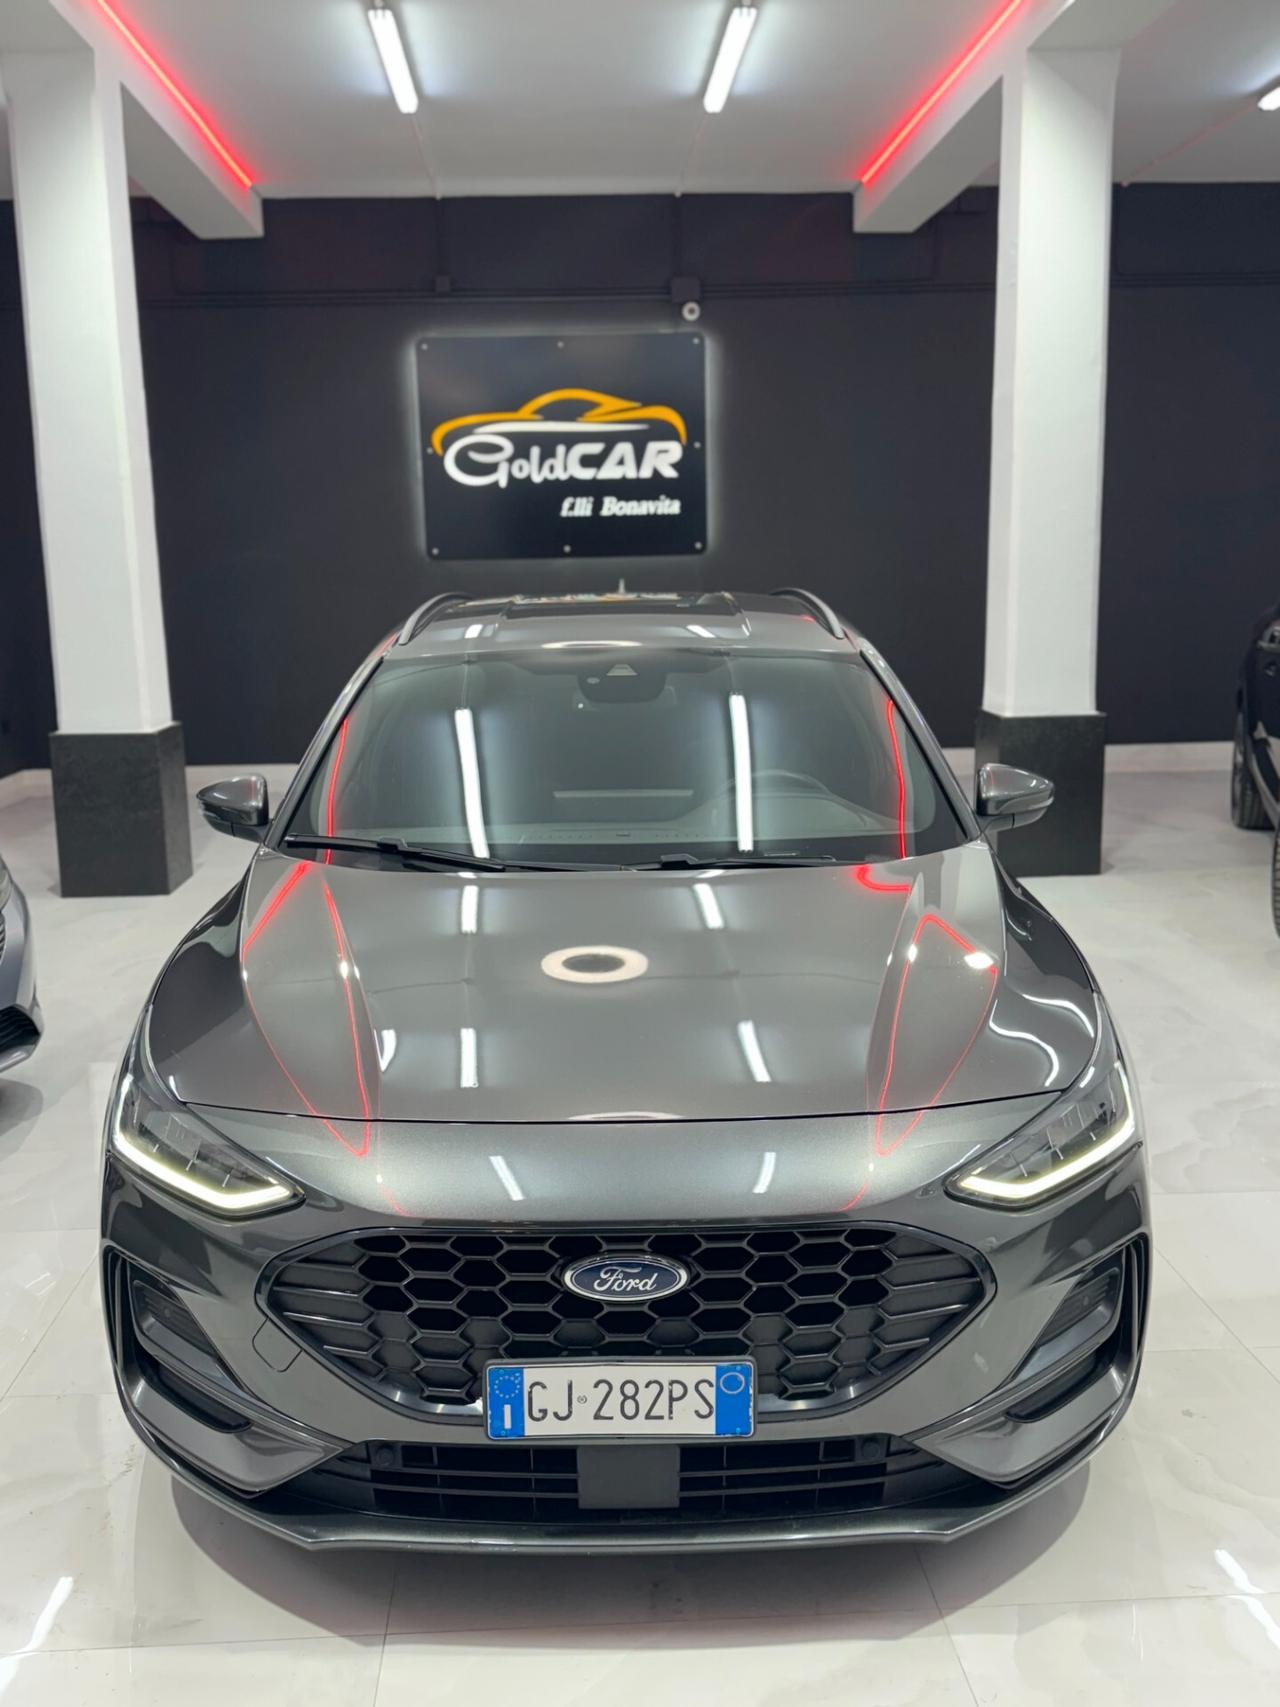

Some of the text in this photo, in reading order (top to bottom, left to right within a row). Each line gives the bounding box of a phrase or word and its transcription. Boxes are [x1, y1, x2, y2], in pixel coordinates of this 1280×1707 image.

[443, 433, 684, 489] GoldCAR
[600, 494, 681, 516] Bonavita
[593, 1266, 659, 1292] Ford
